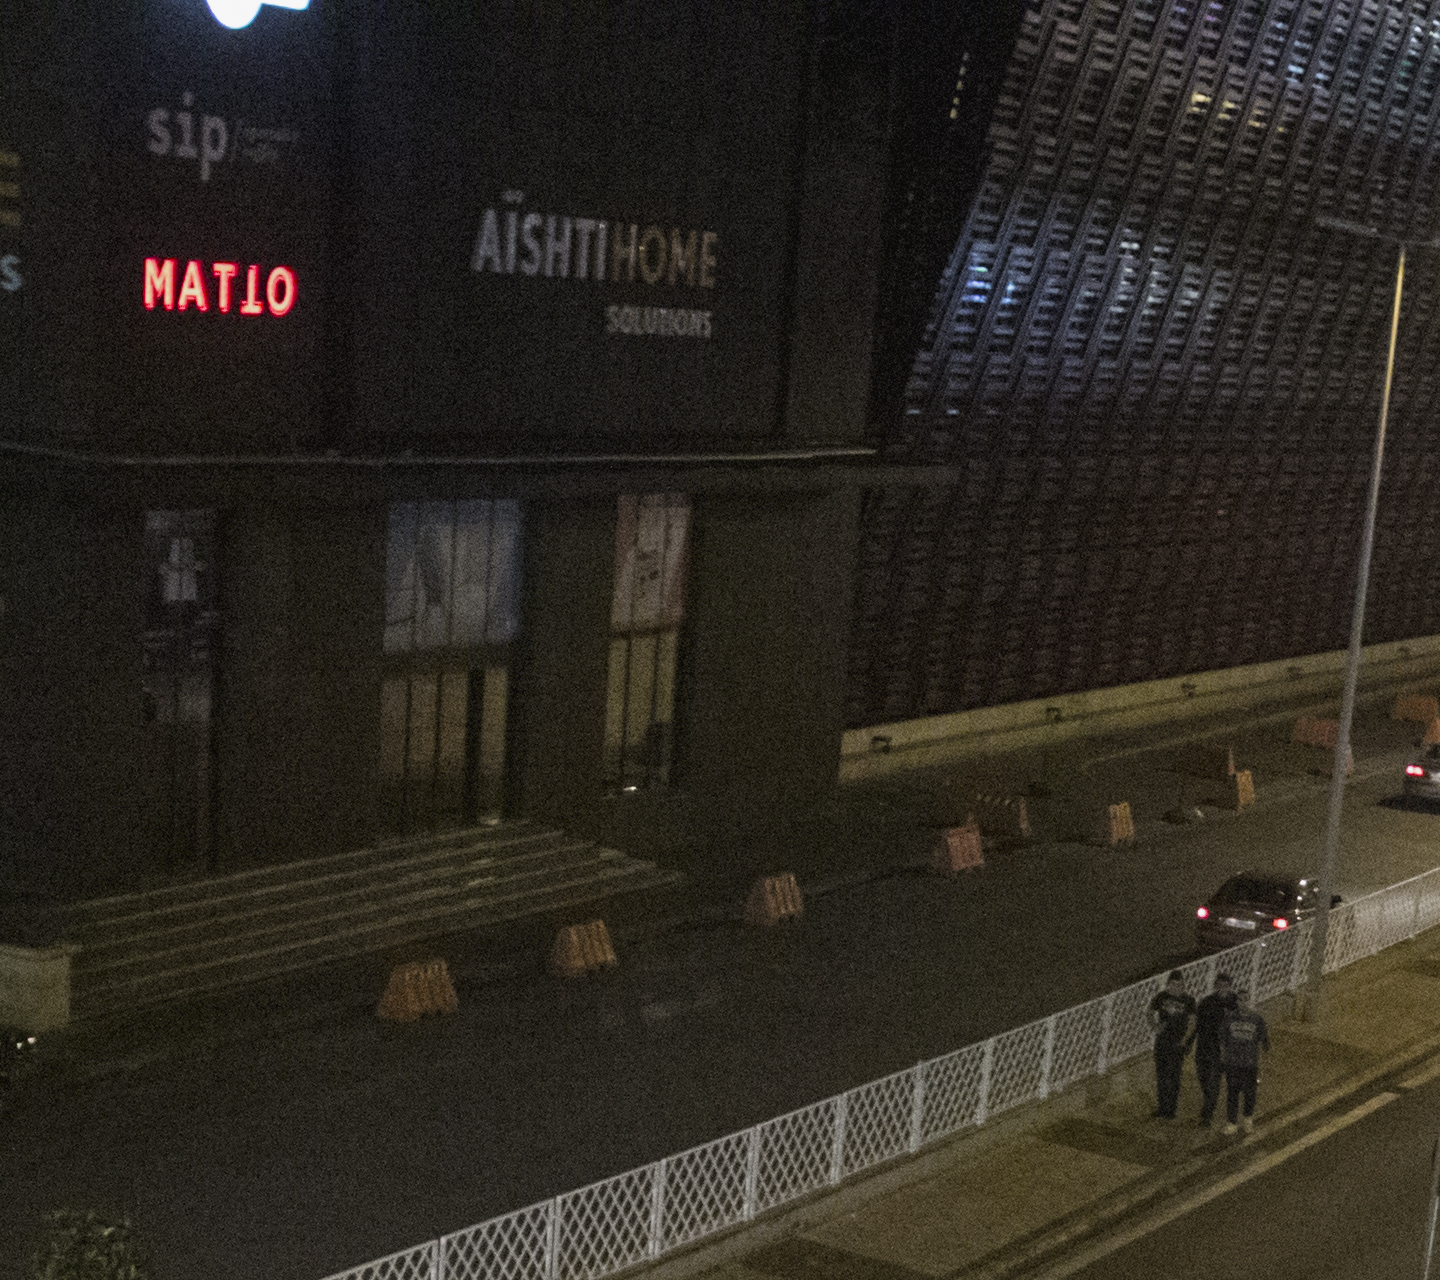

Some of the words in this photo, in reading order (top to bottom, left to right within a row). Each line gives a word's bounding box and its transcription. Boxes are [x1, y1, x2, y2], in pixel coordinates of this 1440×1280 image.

[146, 91, 228, 181] sip
[612, 221, 717, 288] HOME
[608, 304, 711, 338] SOLUTIONS
